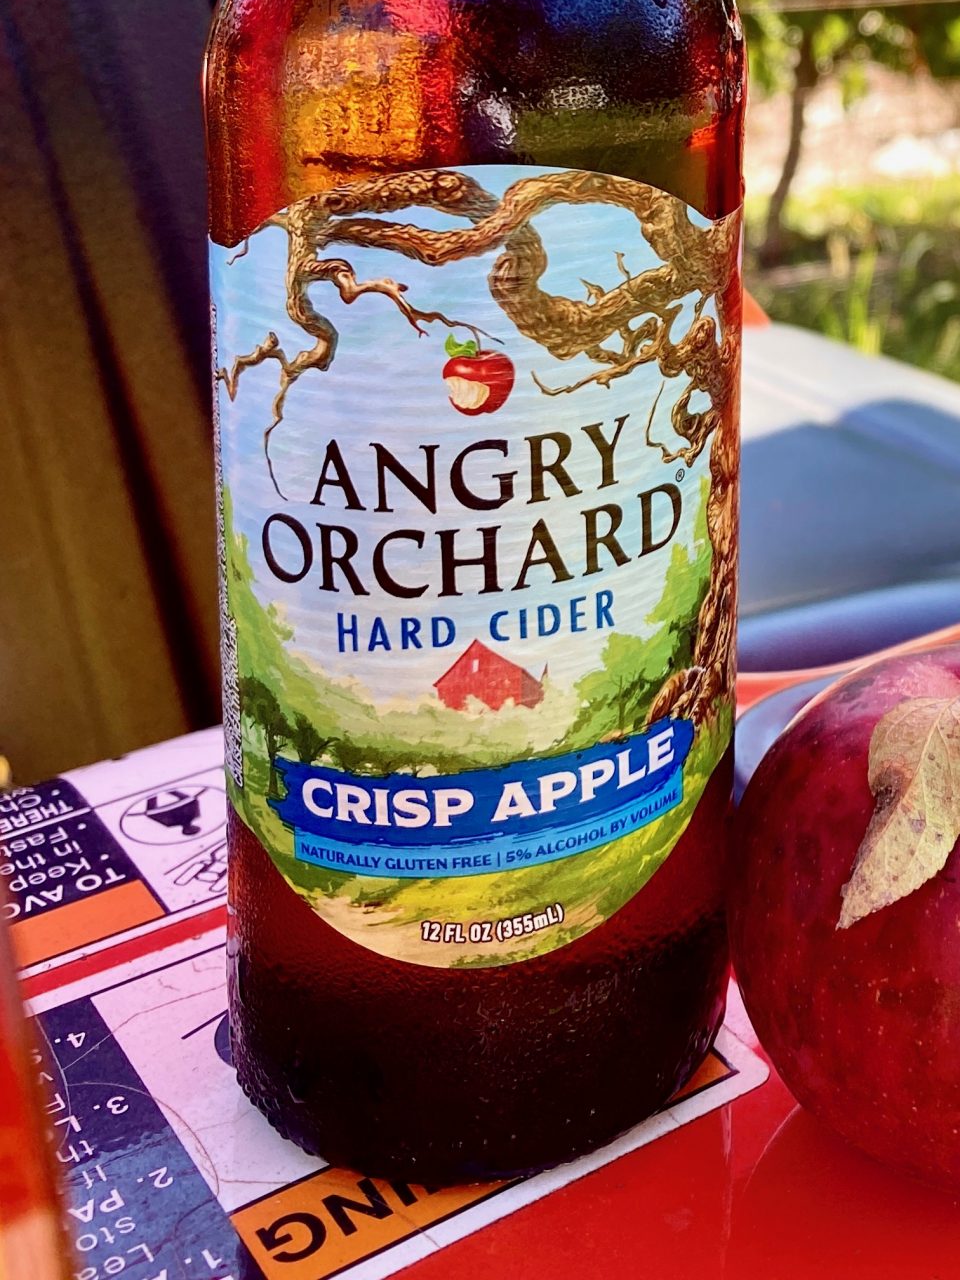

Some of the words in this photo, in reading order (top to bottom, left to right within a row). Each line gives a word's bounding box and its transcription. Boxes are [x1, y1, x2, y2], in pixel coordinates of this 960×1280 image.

[310, 414, 630, 515] ANGRY
[337, 612, 456, 653] HARD
[490, 589, 616, 642] CIDER
[302, 777, 475, 829] CRISP
[491, 725, 675, 822] APPLE
[53, 840, 83, 857] in
[301, 842, 381, 869] NATURALLY
[385, 857, 447, 871] GLUTEN
[452, 853, 492, 869] FREE
[506, 847, 532, 864] 5%
[535, 826, 608, 858] ALCOHOL
[610, 817, 629, 834] BY
[630, 788, 679, 825] VOLUME
[0, 852, 46, 876] the
[9, 856, 91, 892] Keep
[75, 867, 126, 892] TO
[421, 921, 441, 942] 12
[444, 923, 466, 943] FL
[469, 922, 493, 943] OZ
[496, 902, 564, 942] (355mL)
